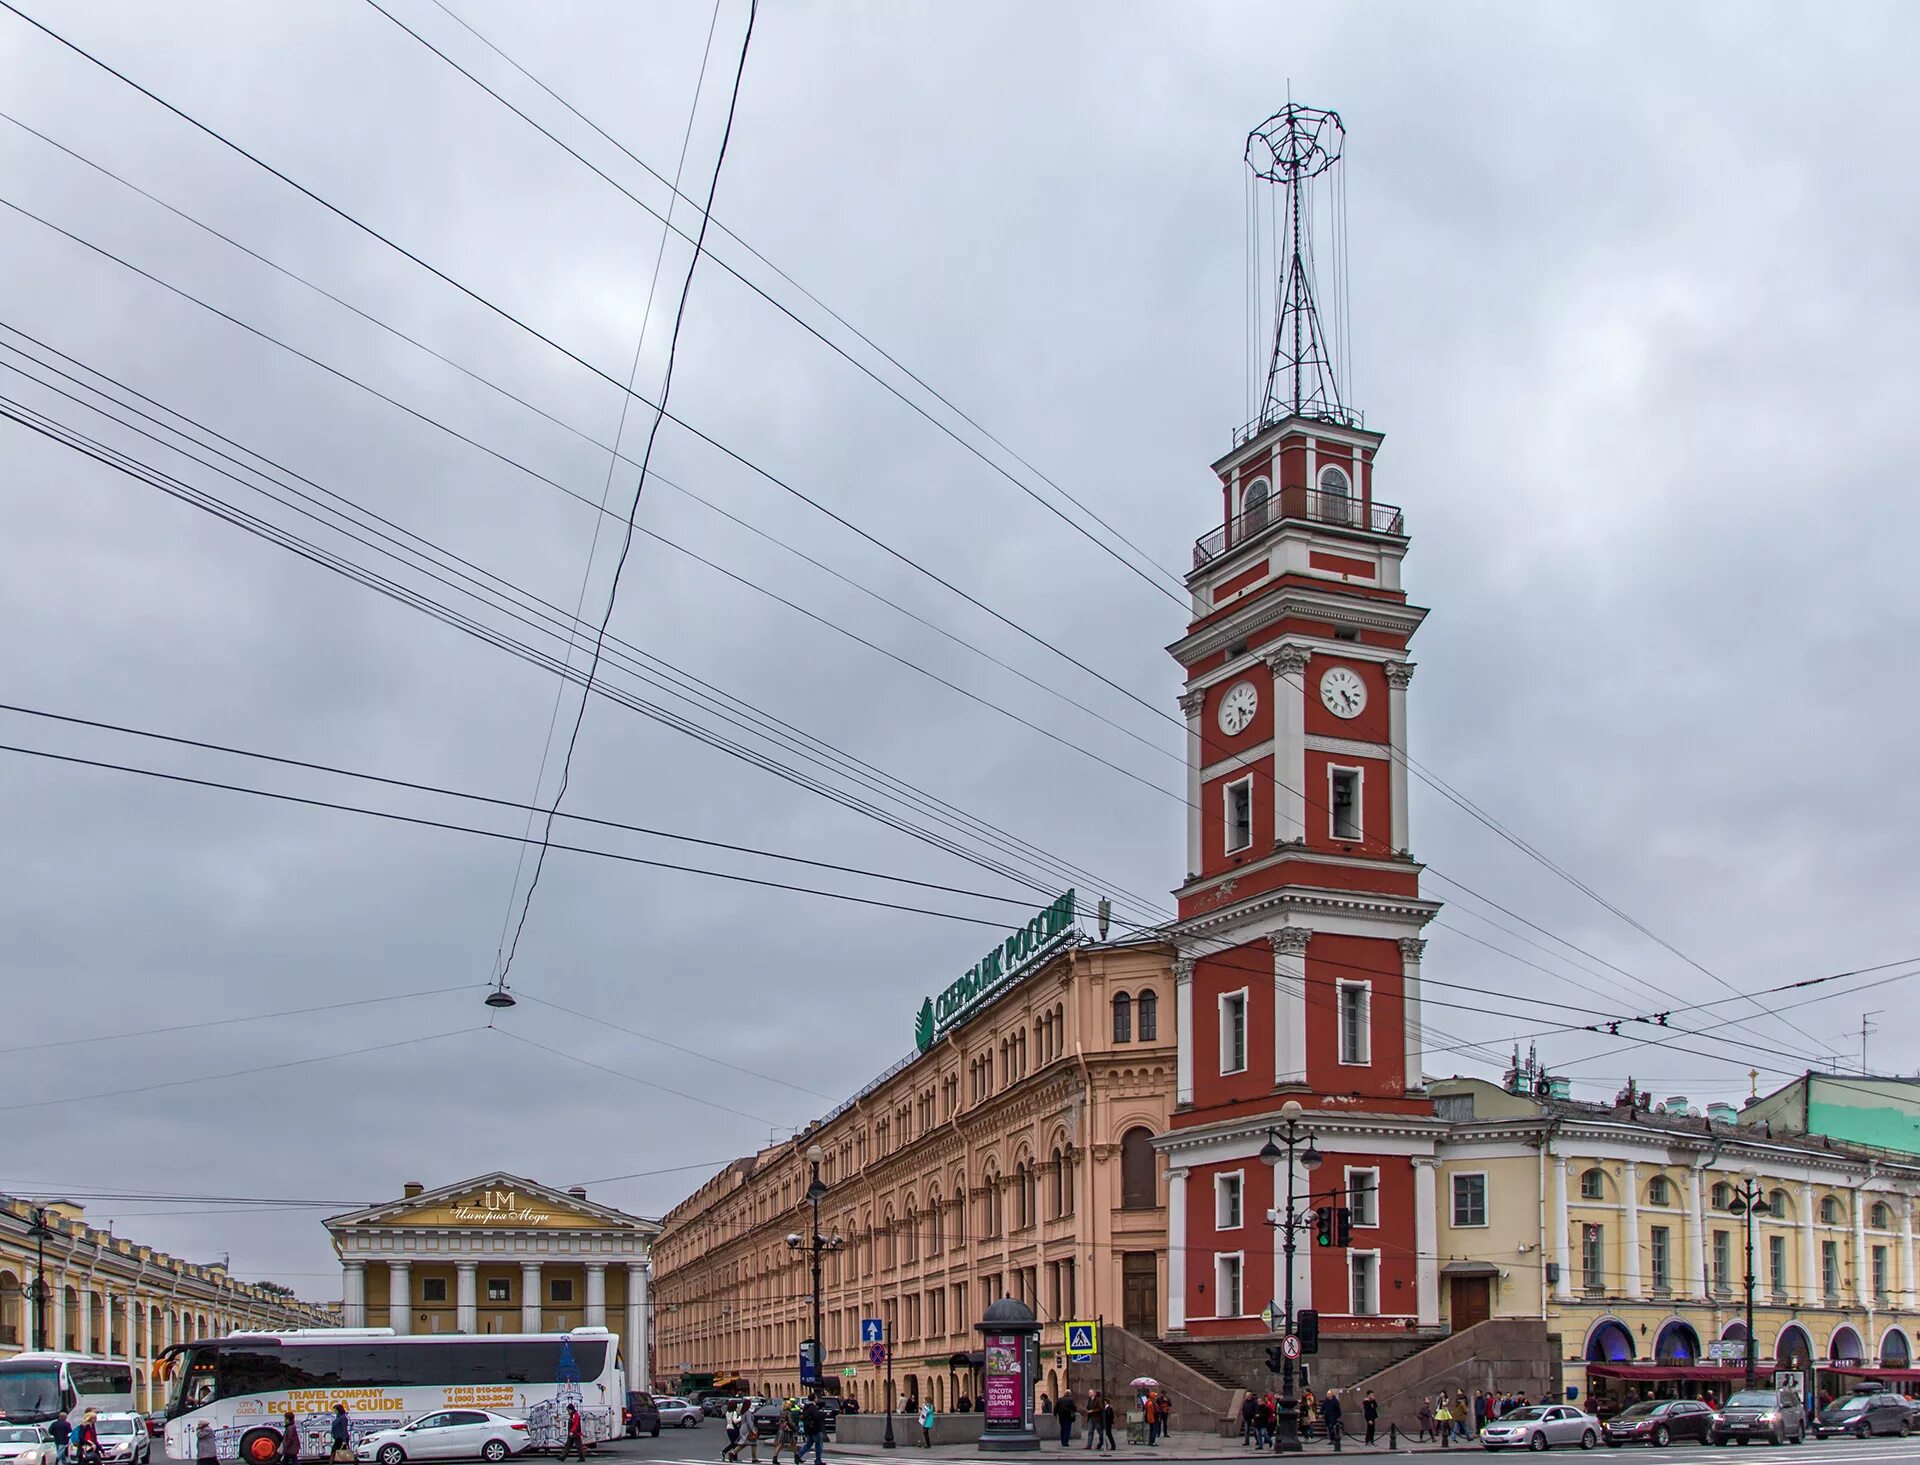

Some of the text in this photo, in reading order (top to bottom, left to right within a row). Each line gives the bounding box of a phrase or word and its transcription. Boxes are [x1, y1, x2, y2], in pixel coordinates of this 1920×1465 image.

[936, 888, 1075, 1024] СБЕРБАНК РОССИИ
[450, 1207, 507, 1224] Империя
[287, 1388, 385, 1400] TRAVEL COMPANY
[239, 1400, 254, 1408] CITY
[267, 1398, 404, 1414] ECLECTICA-GUIDE
